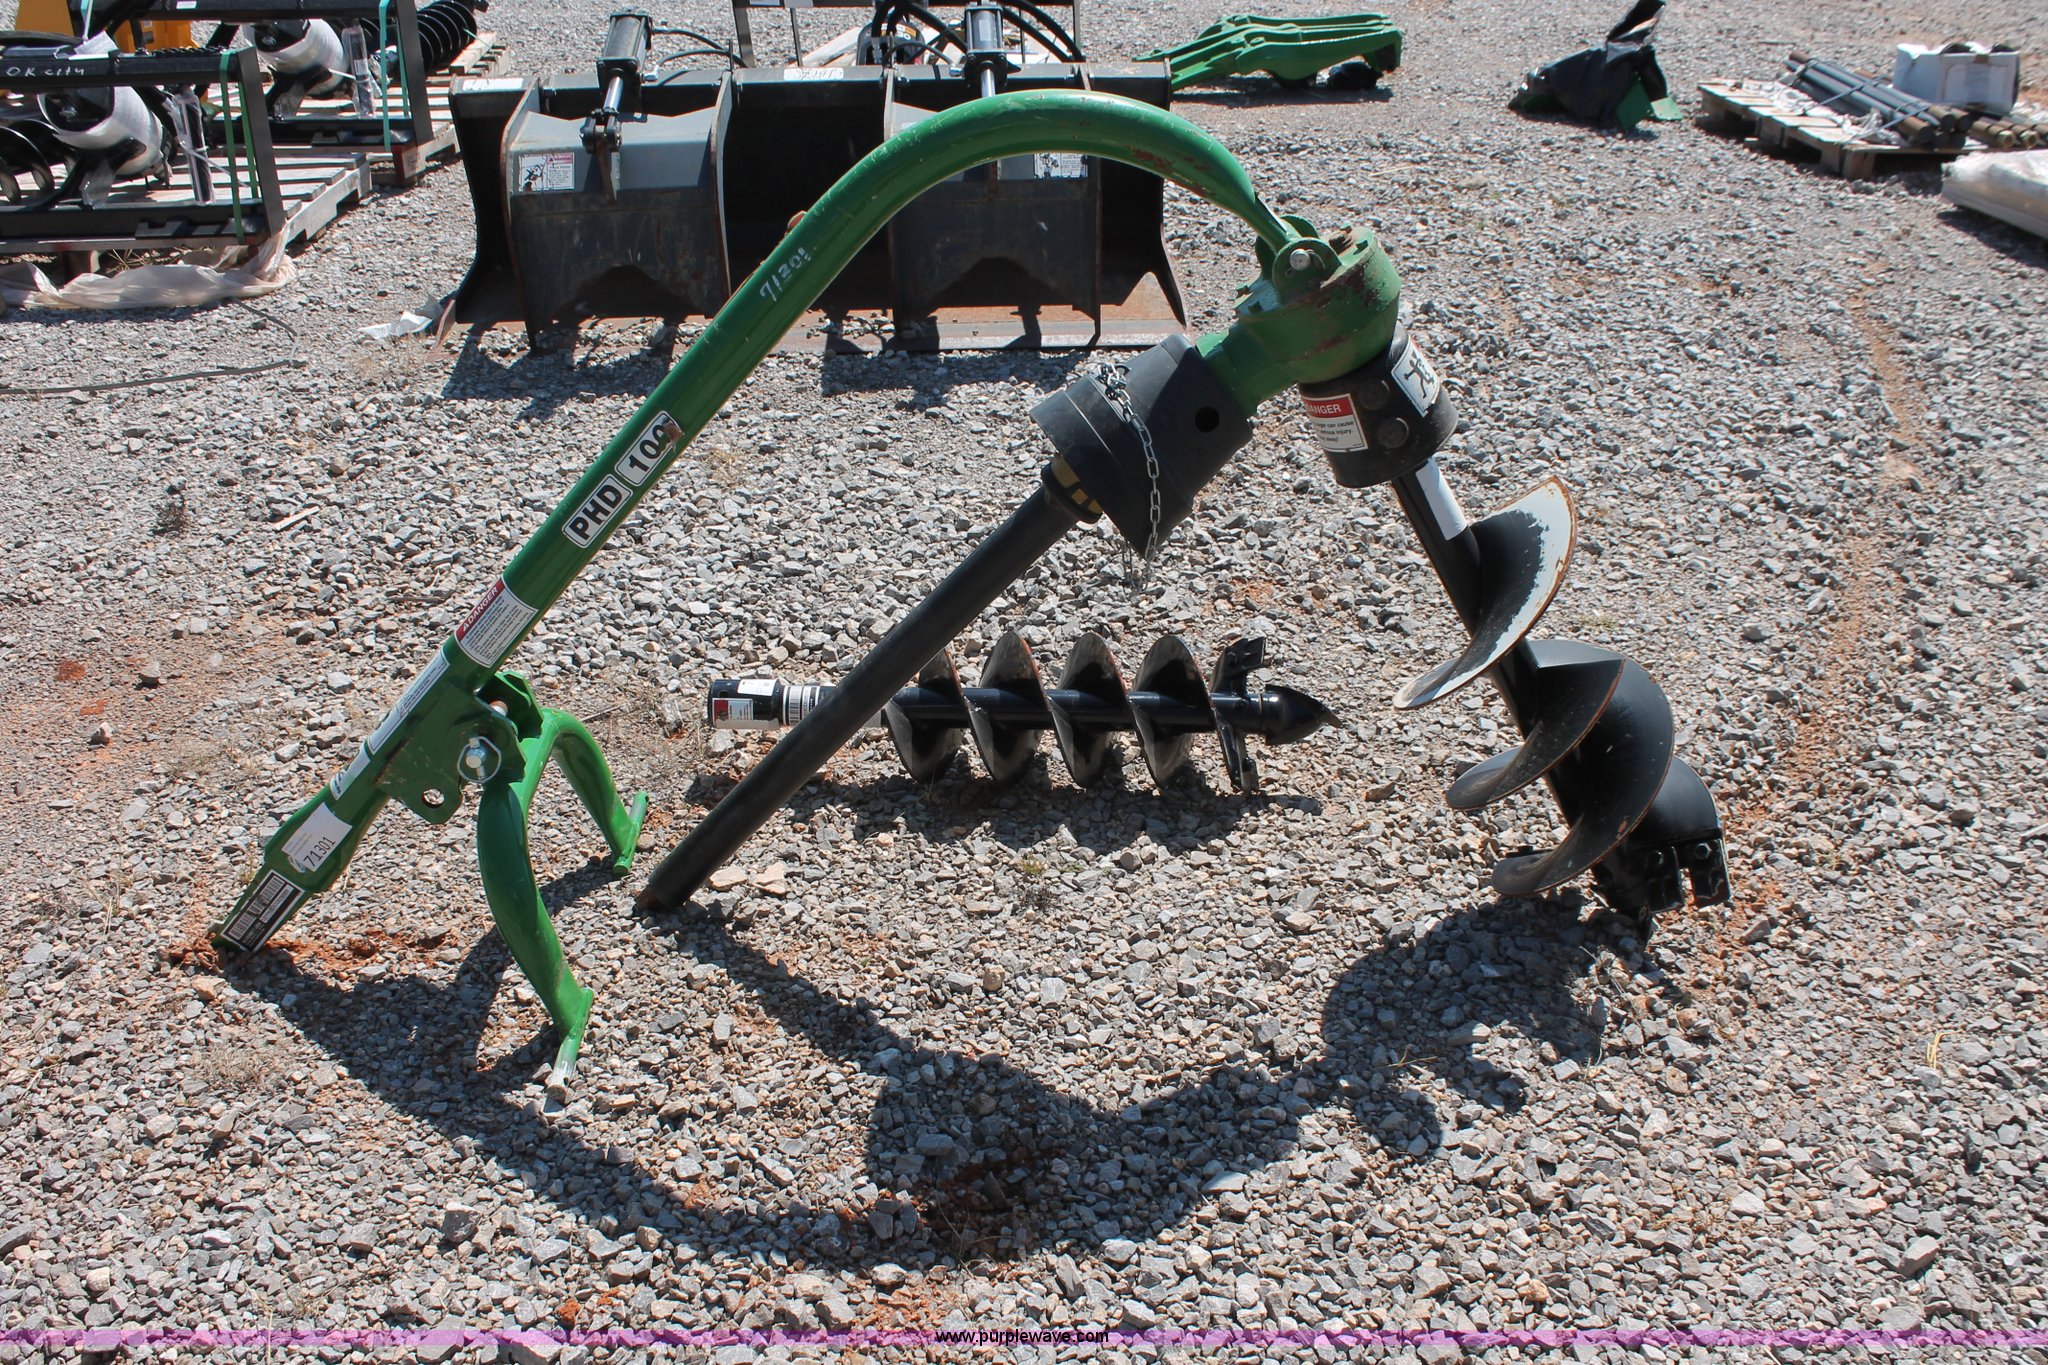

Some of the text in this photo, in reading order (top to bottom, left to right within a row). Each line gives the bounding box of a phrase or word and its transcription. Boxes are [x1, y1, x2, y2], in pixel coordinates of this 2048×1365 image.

[1305, 403, 1342, 415] ANGER
[568, 484, 623, 541] PHD
[467, 585, 498, 623] DANGER
[303, 835, 336, 868] 71301
